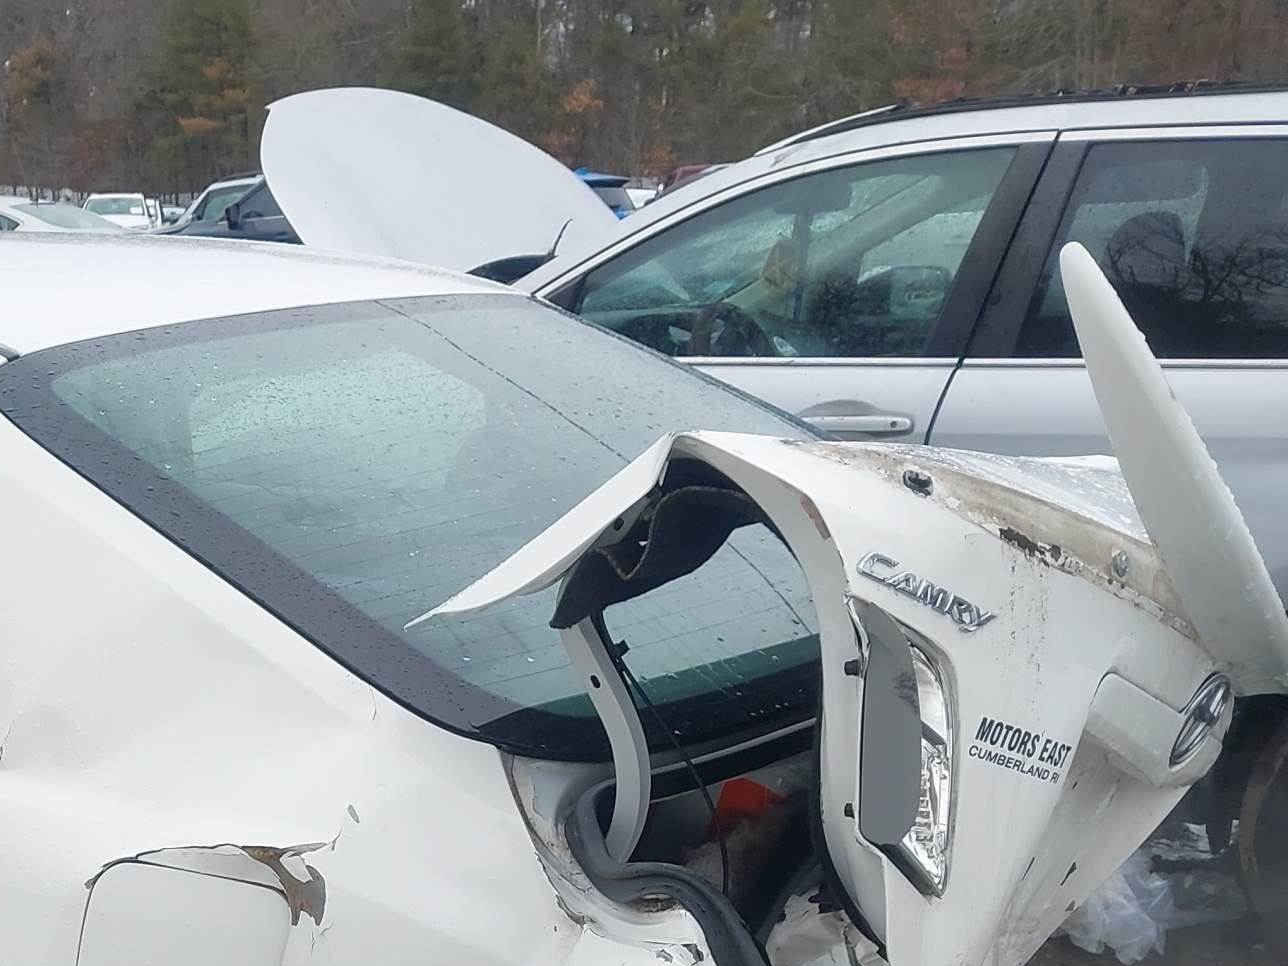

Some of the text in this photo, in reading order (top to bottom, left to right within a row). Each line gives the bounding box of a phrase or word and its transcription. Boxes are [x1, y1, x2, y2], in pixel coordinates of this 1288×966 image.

[856, 552, 997, 633] CAMRY
[968, 745, 1061, 784] CUMBERLAND RI
[975, 716, 1072, 768] MOTORS EAST
